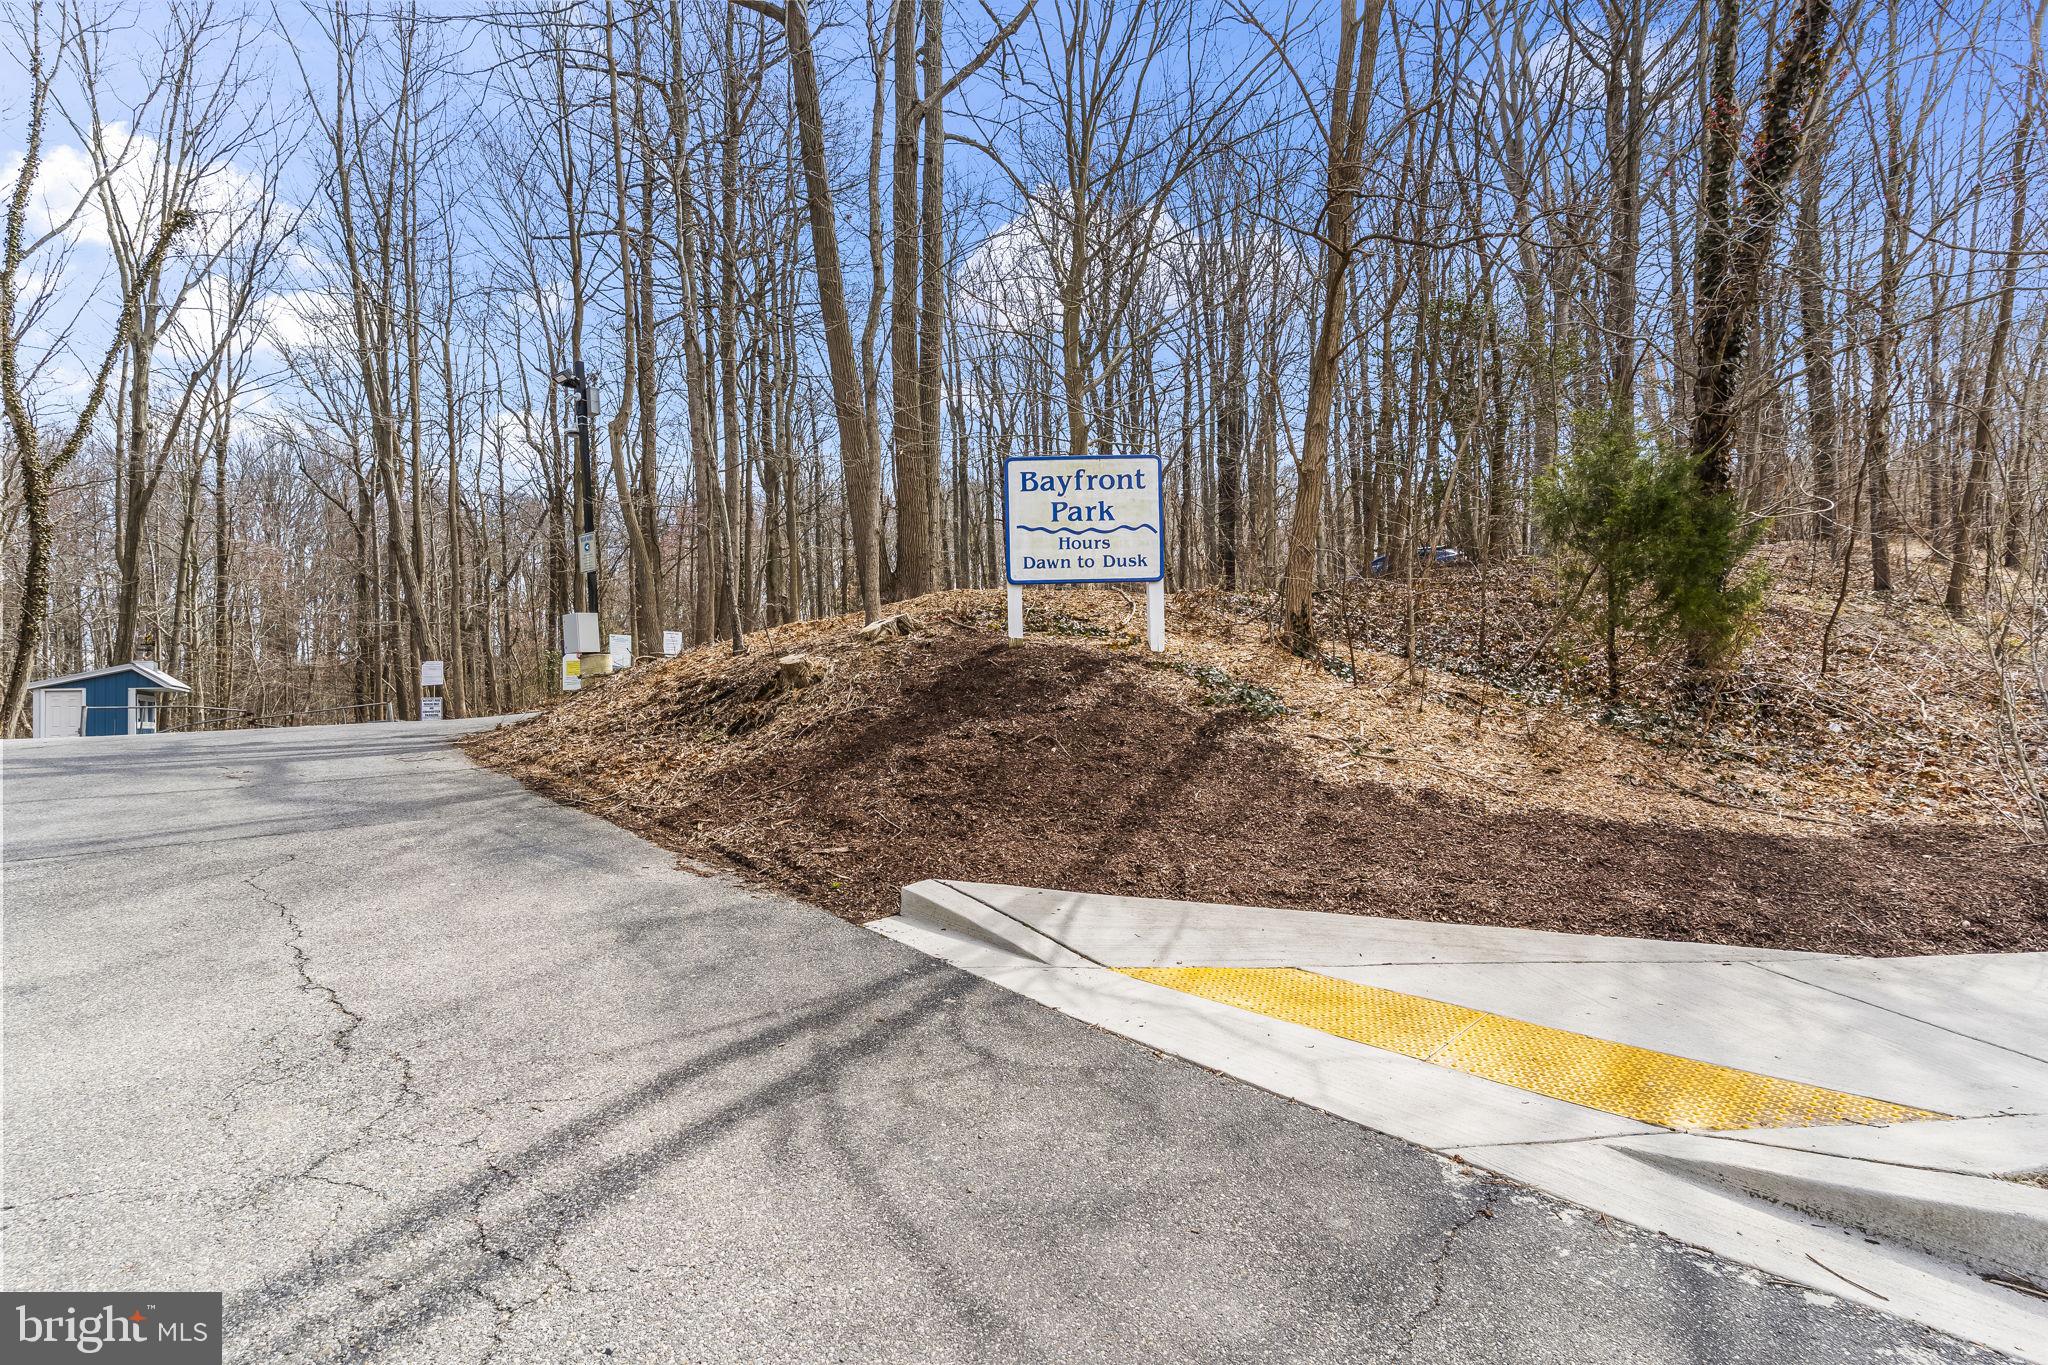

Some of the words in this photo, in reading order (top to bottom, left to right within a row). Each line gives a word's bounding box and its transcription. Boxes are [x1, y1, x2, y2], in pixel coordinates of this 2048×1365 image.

[1019, 469, 1146, 497] Bayfront
[1051, 501, 1115, 522] Park
[1058, 536, 1111, 550] Hours
[1023, 556, 1071, 570] Dawn
[1077, 555, 1095, 569] to
[1103, 554, 1148, 568] Dusk
